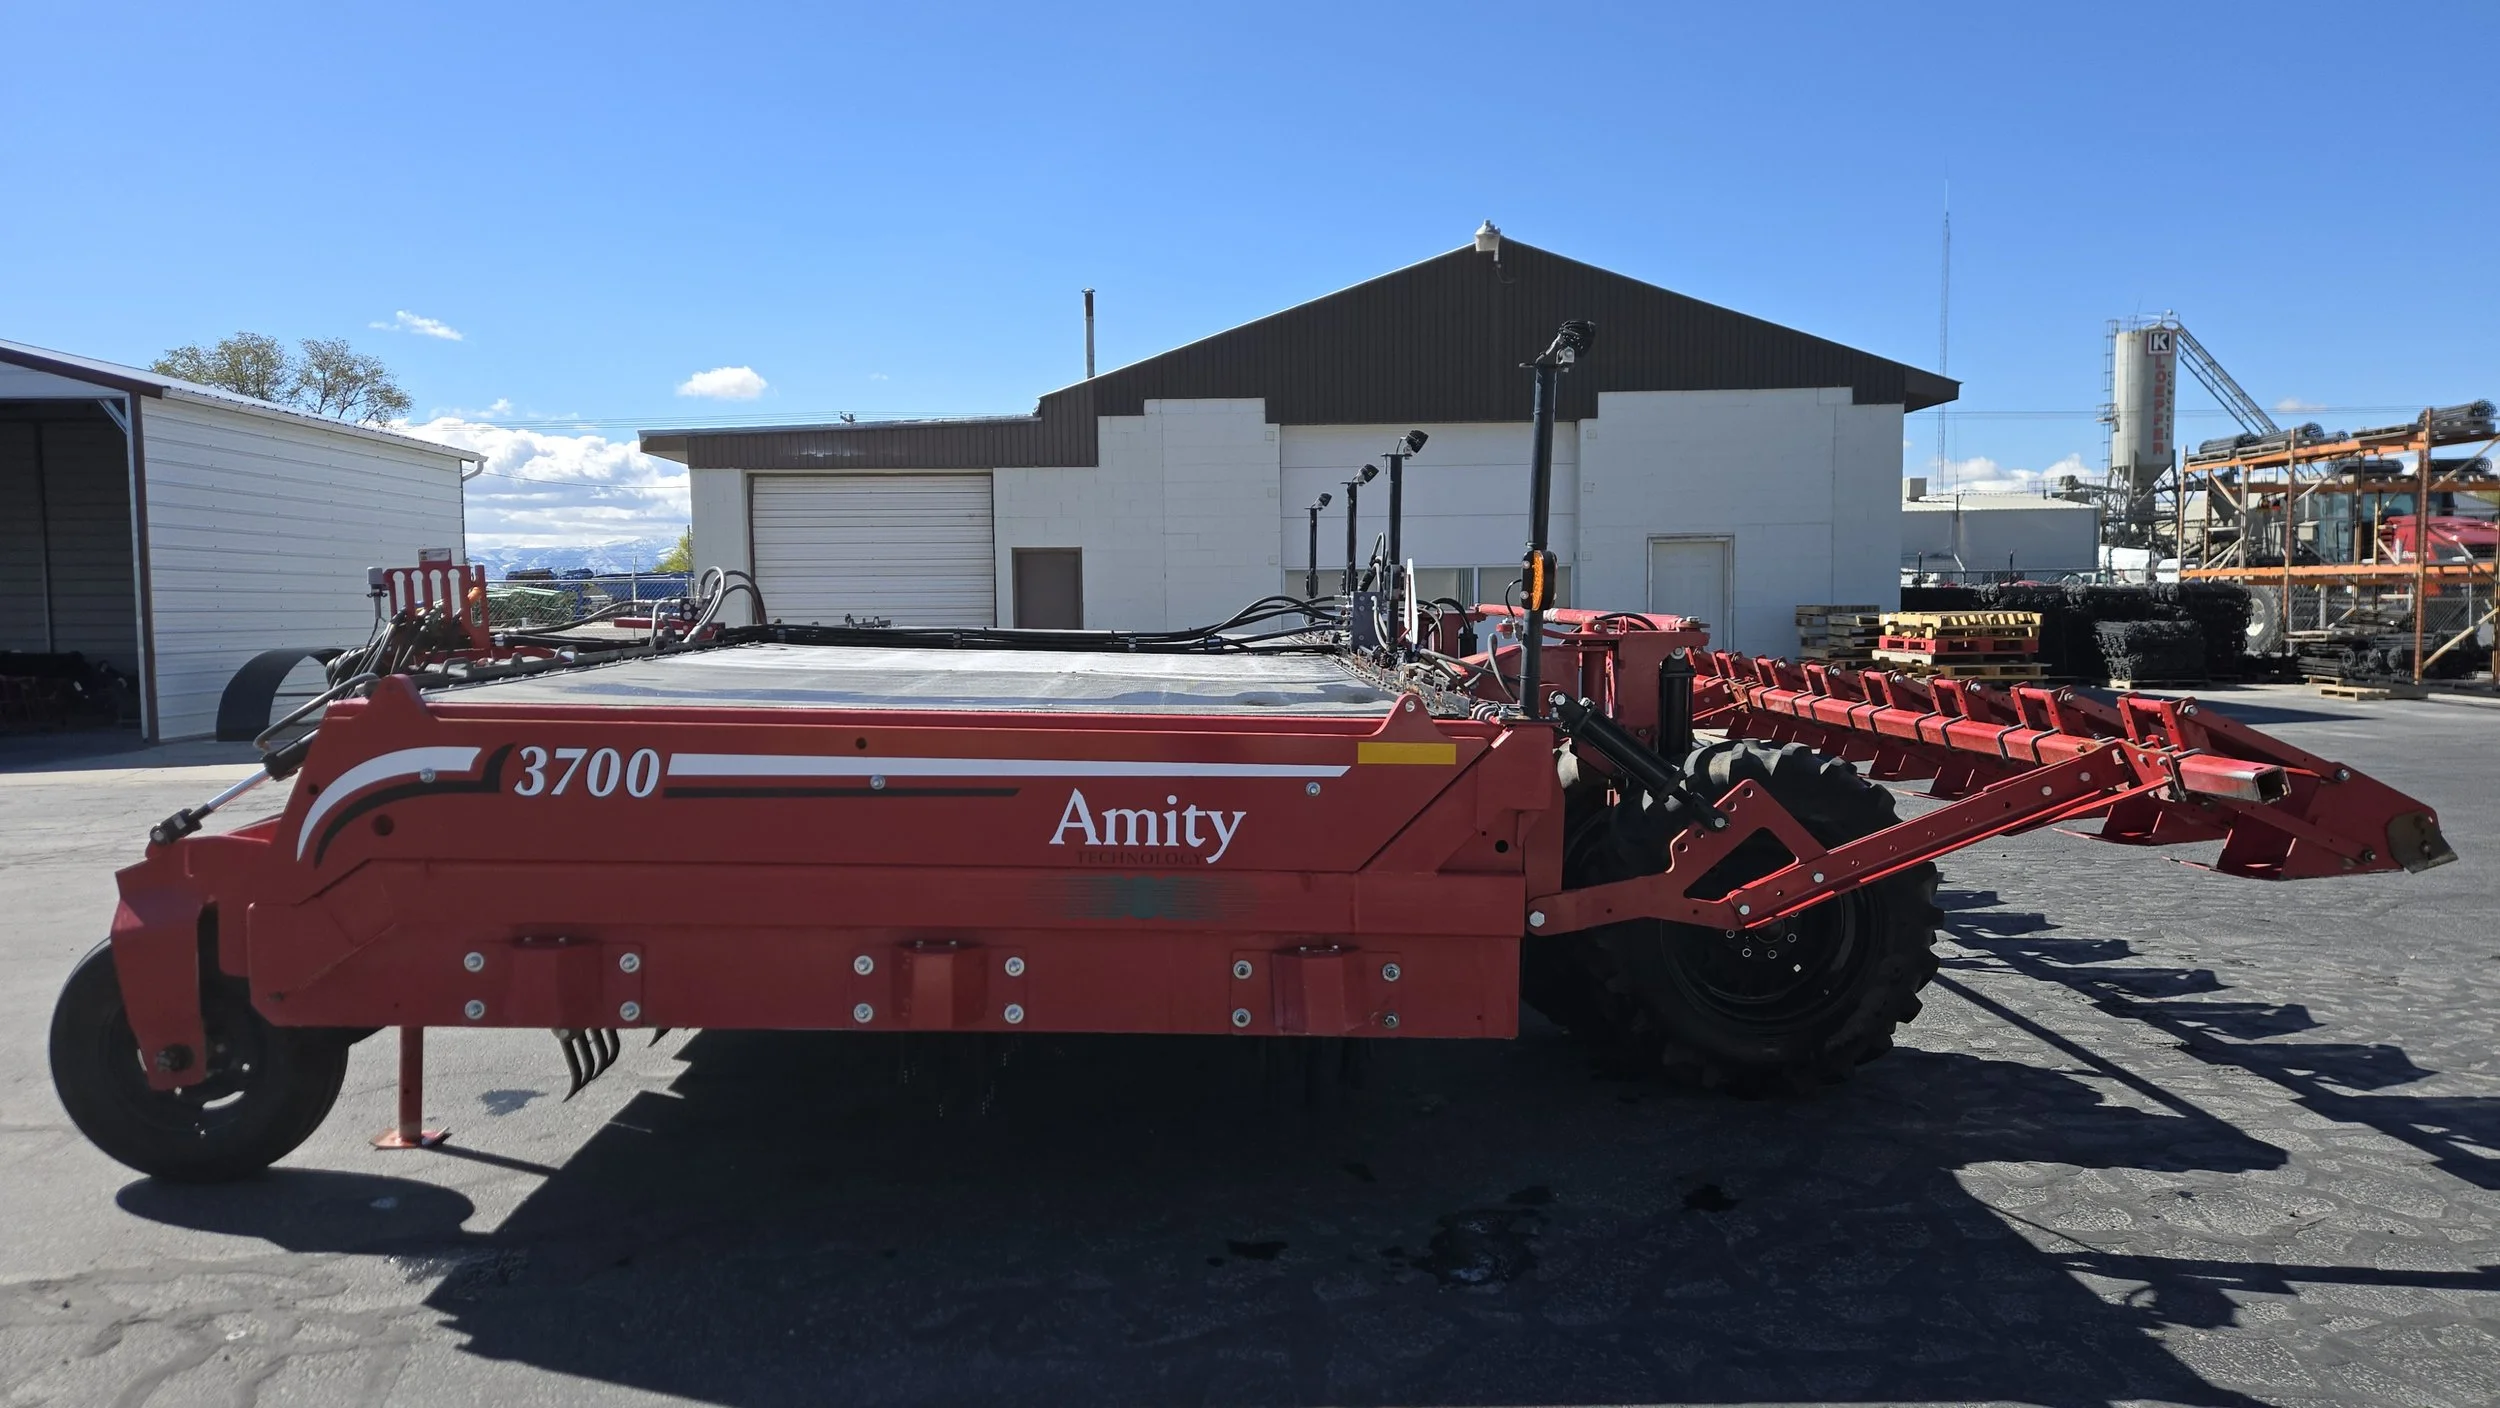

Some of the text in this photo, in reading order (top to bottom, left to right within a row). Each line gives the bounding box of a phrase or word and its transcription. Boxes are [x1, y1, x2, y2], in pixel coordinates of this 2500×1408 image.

[2153, 333, 2168, 351] K
[513, 745, 661, 798] 3700
[1048, 787, 1247, 864] Amity
[1076, 850, 1204, 866] TECHNOLOGY
